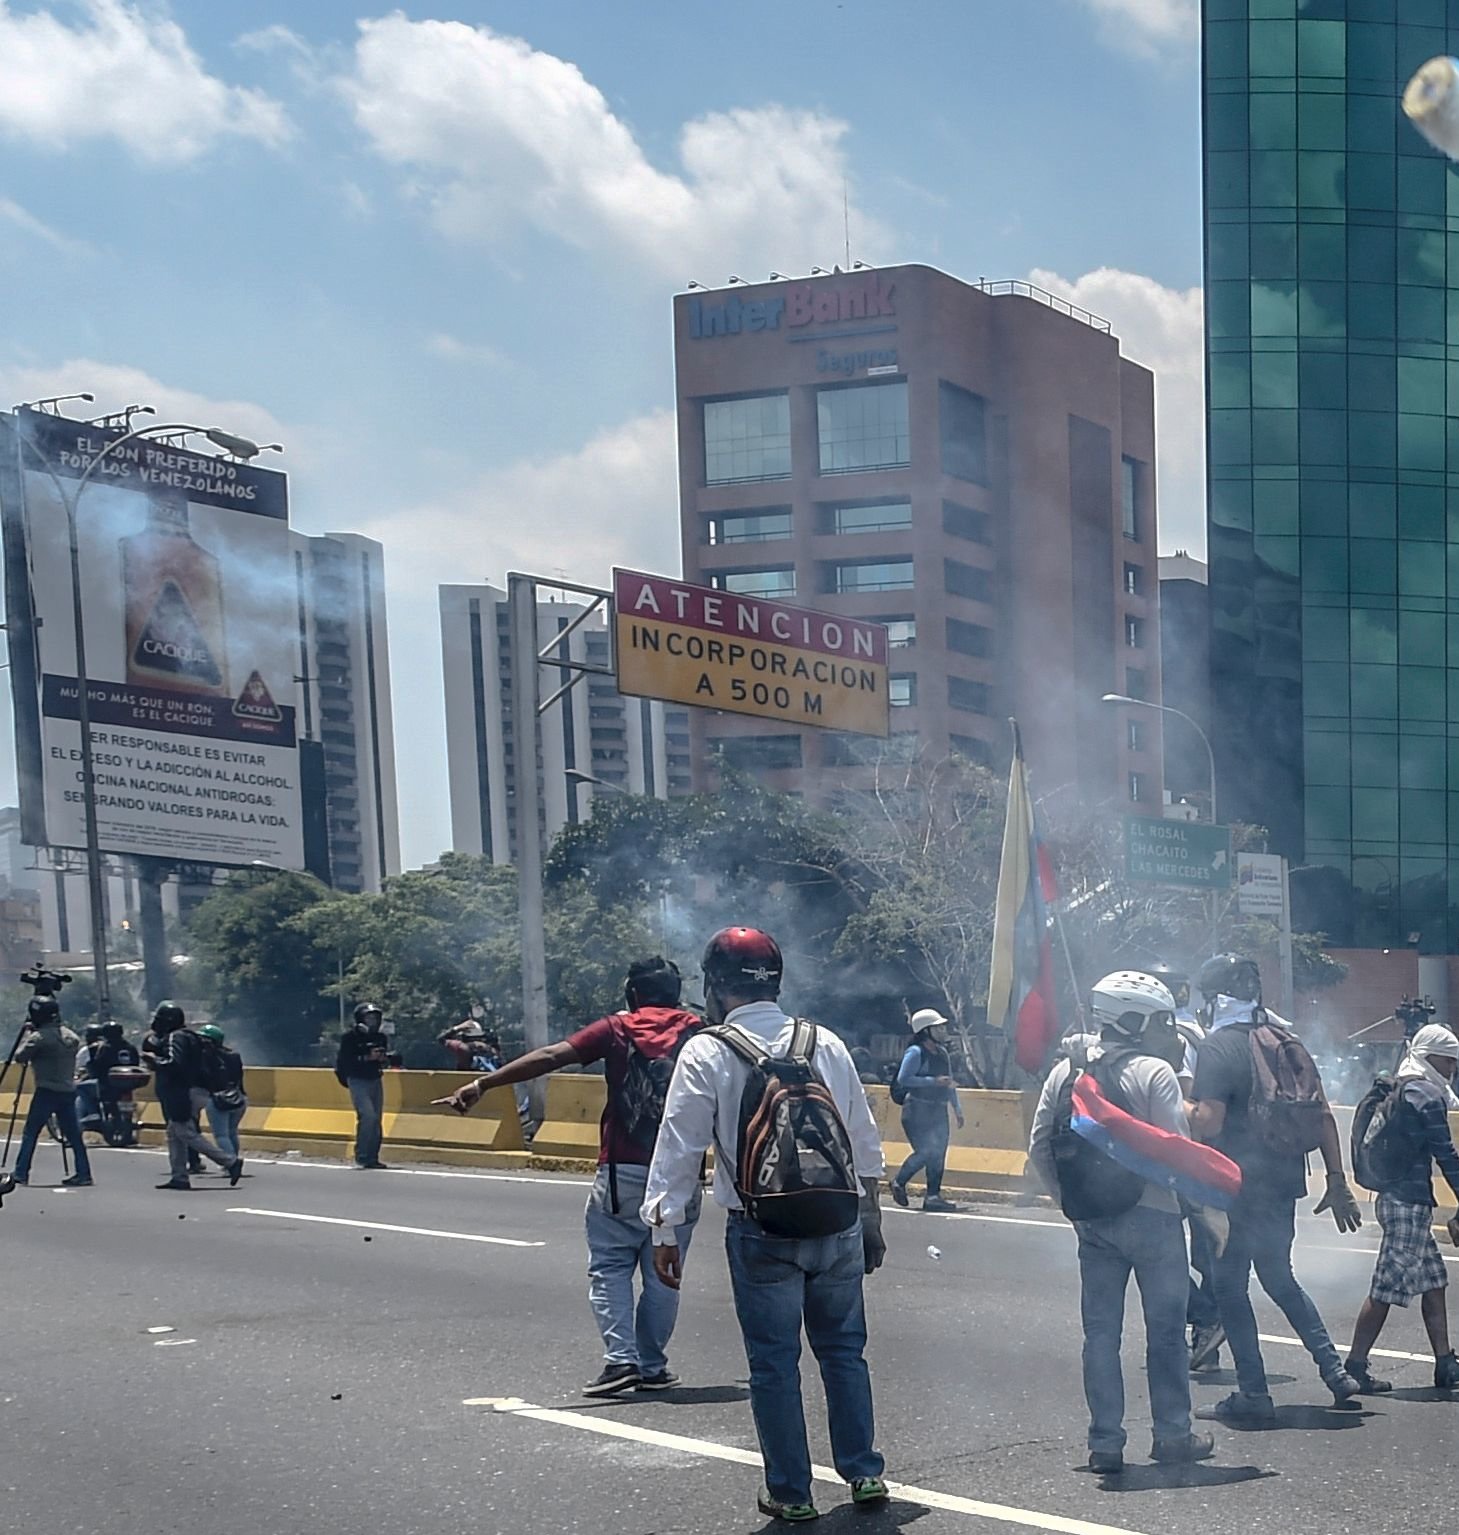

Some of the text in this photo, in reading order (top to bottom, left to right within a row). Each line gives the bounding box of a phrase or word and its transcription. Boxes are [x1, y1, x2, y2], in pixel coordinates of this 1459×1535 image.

[689, 271, 896, 340] InterBank
[816, 347, 897, 376] Seguros
[60, 451, 92, 470] POR
[101, 460, 131, 477] LOS
[77, 437, 99, 453] EL
[146, 449, 237, 480] PREFERIDO
[634, 583, 874, 657] ATENCION
[143, 640, 208, 663] CACIQUE
[632, 625, 876, 693] INCORPORACION
[60, 687, 106, 702] MUHO
[139, 697, 164, 710] QUE
[167, 700, 184, 712] UN
[696, 673, 823, 715] A 500 M
[132, 708, 146, 719] ES
[149, 709, 161, 720] EL
[87, 731, 266, 767] ER RESPONSABLE ES EVITAR
[51, 747, 67, 760] EL
[125, 756, 133, 768] Y
[137, 758, 153, 772] LA
[156, 761, 212, 780] ADICCIÓN
[215, 770, 231, 782] AL
[233, 773, 293, 790] ALCOHOL.
[130, 778, 192, 797] NACIONAL
[147, 801, 204, 818] VALORES
[207, 808, 238, 823] PARA
[241, 813, 257, 825] LA
[259, 815, 289, 829] VIDA.
[1130, 823, 1187, 842] EL ROSAL
[1131, 842, 1189, 860] CHACAITO
[1131, 860, 1211, 880] LAS MERCEDES
